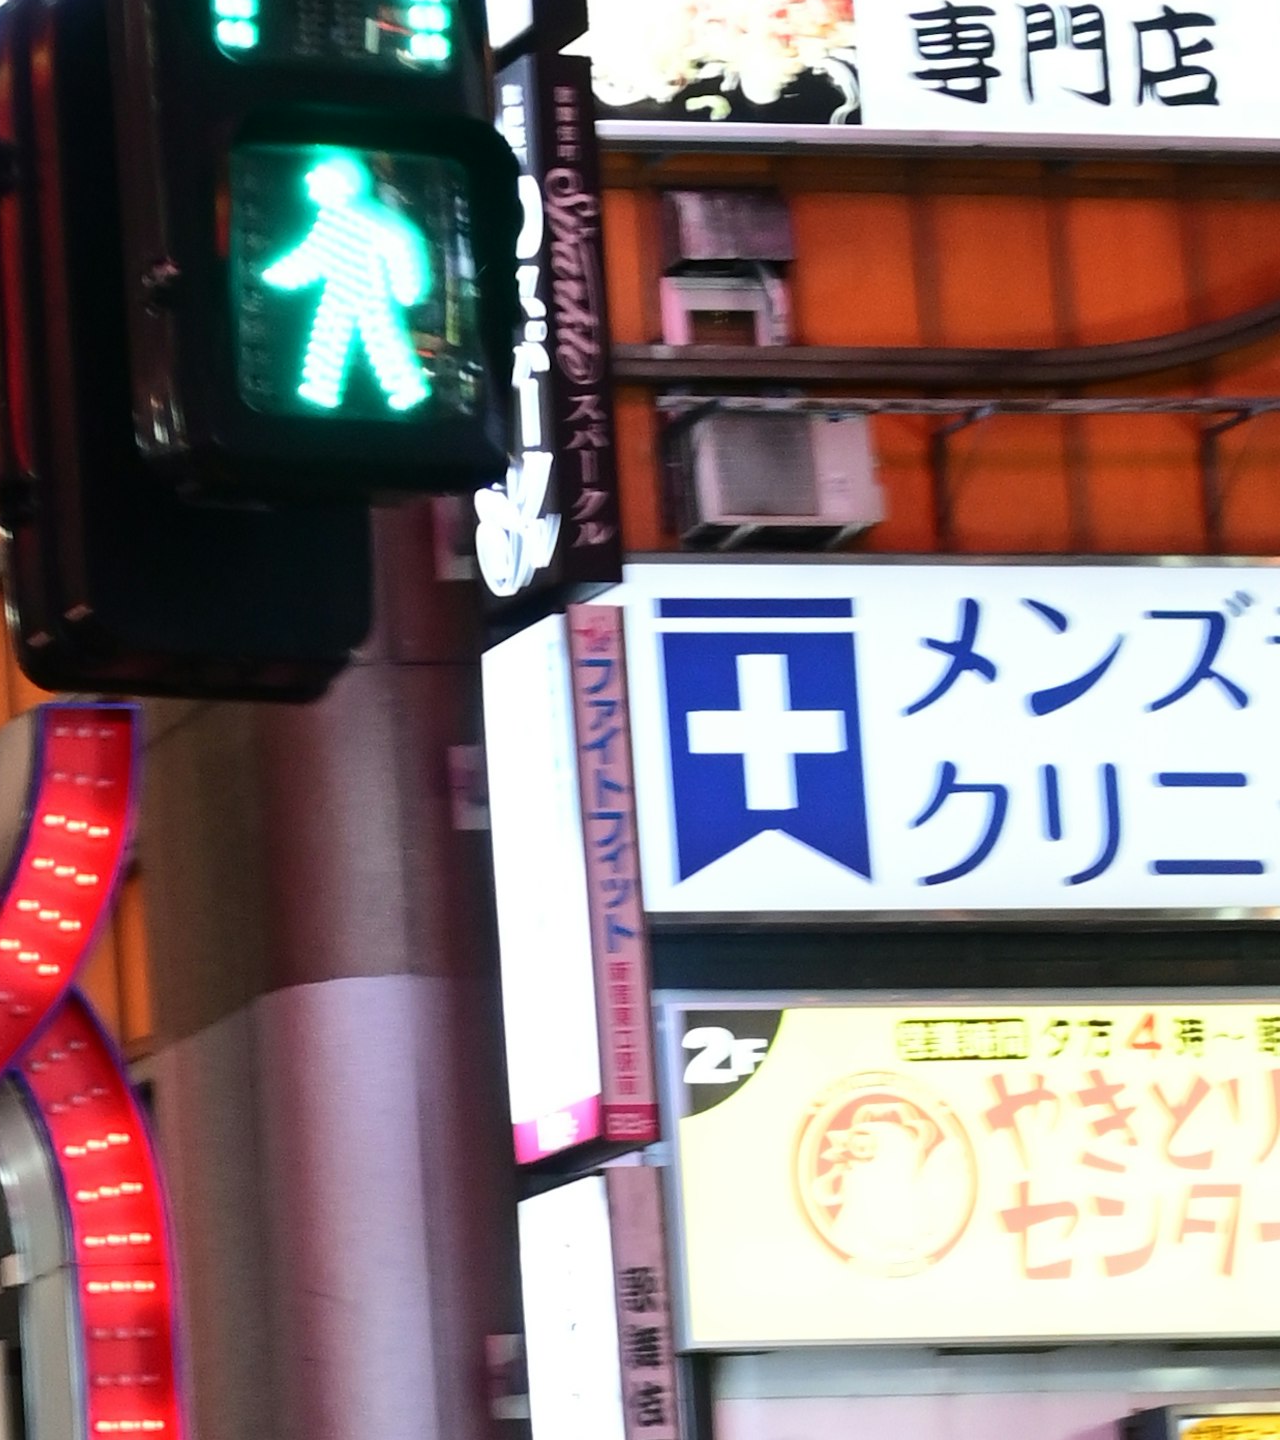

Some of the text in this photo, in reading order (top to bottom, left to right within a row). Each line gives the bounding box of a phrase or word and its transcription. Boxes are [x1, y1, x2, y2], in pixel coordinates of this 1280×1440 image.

[908, 0, 1220, 107] 専門店
[899, 590, 1280, 717] メンズ
[681, 1026, 768, 1084] 2F
[983, 1068, 1280, 1173] やきとり
